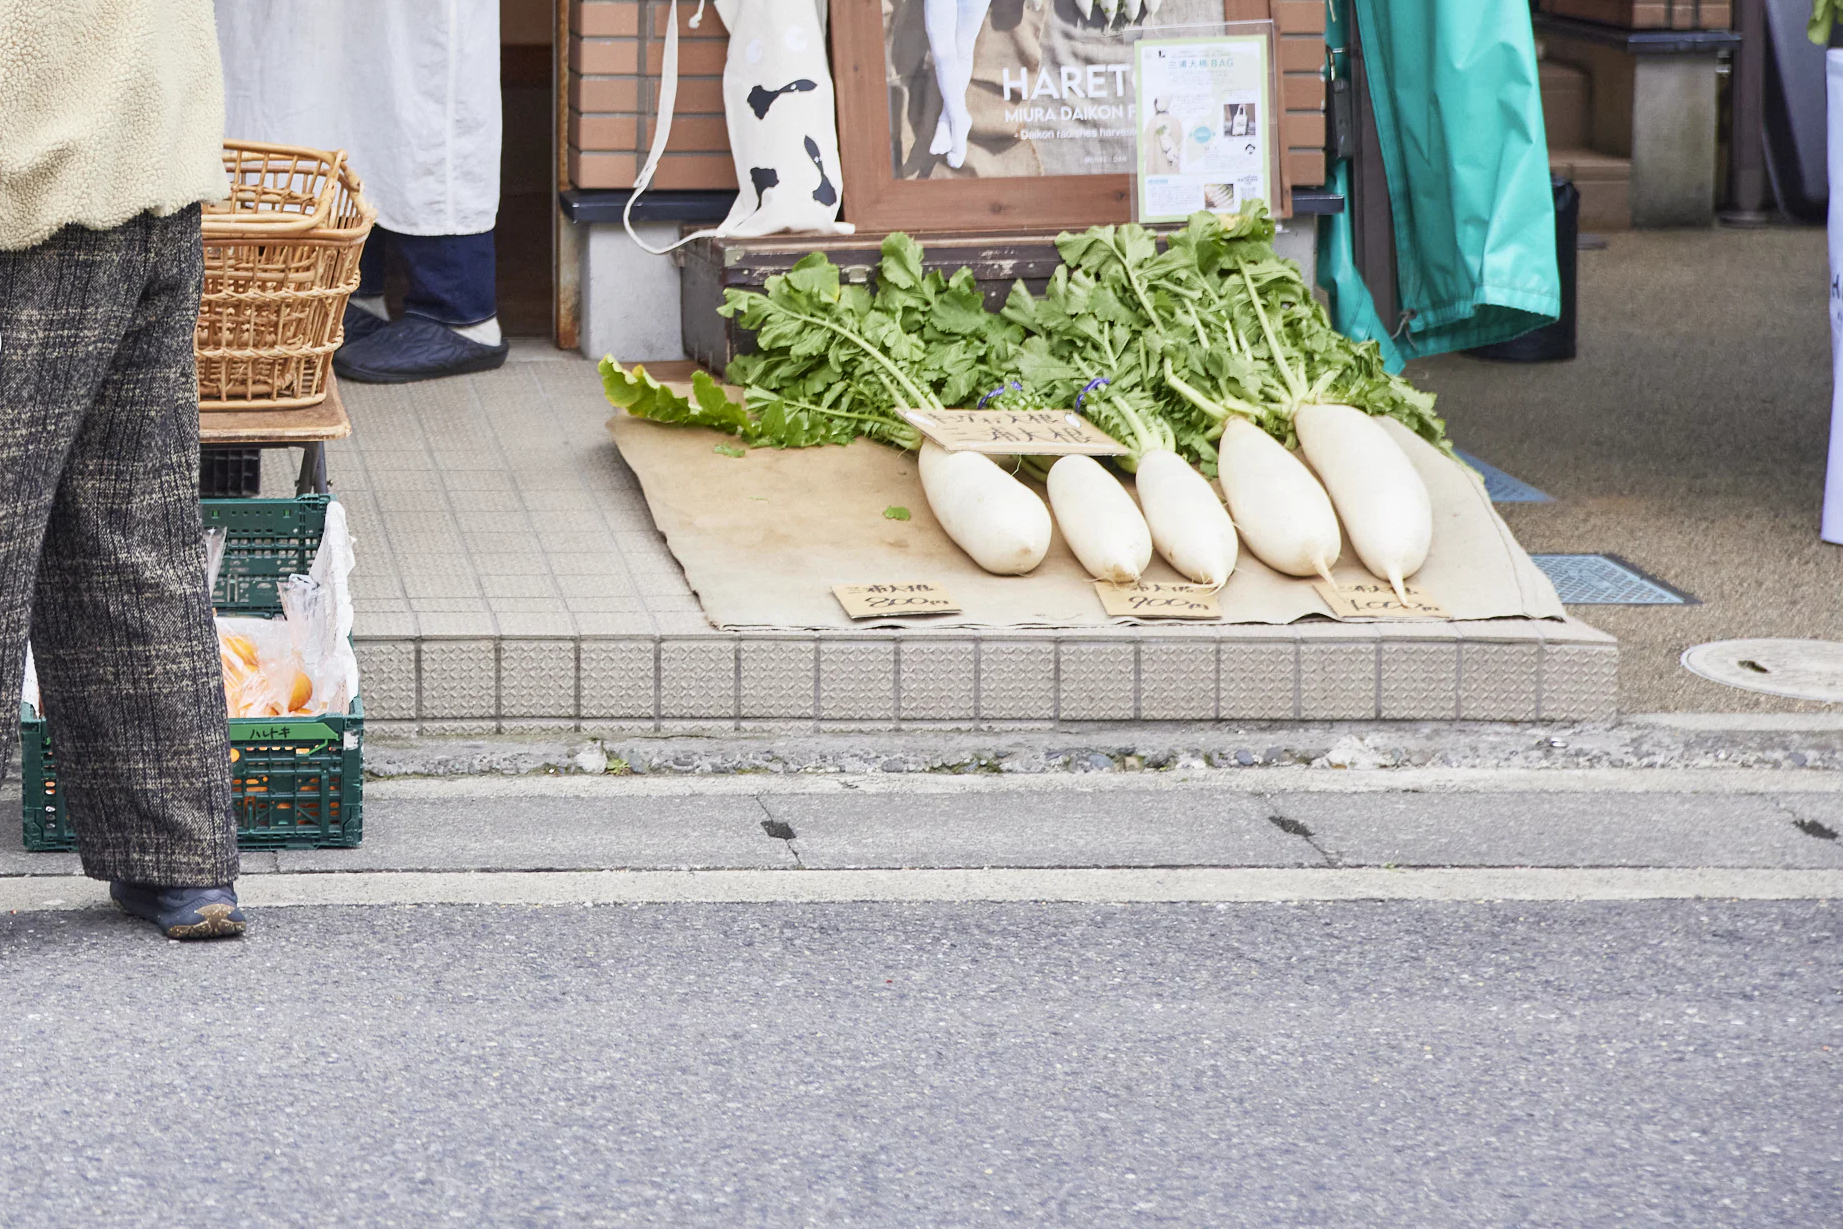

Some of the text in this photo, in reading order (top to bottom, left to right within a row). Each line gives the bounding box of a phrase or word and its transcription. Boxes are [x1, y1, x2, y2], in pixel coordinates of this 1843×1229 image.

[1211, 58, 1234, 68] BAG
[1002, 63, 1136, 101] HARET
[1004, 106, 1056, 123] MIURA
[1060, 105, 1123, 122] DAIKON
[1021, 130, 1054, 140] Daikon
[1056, 128, 1097, 139] radishes
[1128, 596, 1210, 610] 900円
[250, 726, 291, 739] ハレトキ
